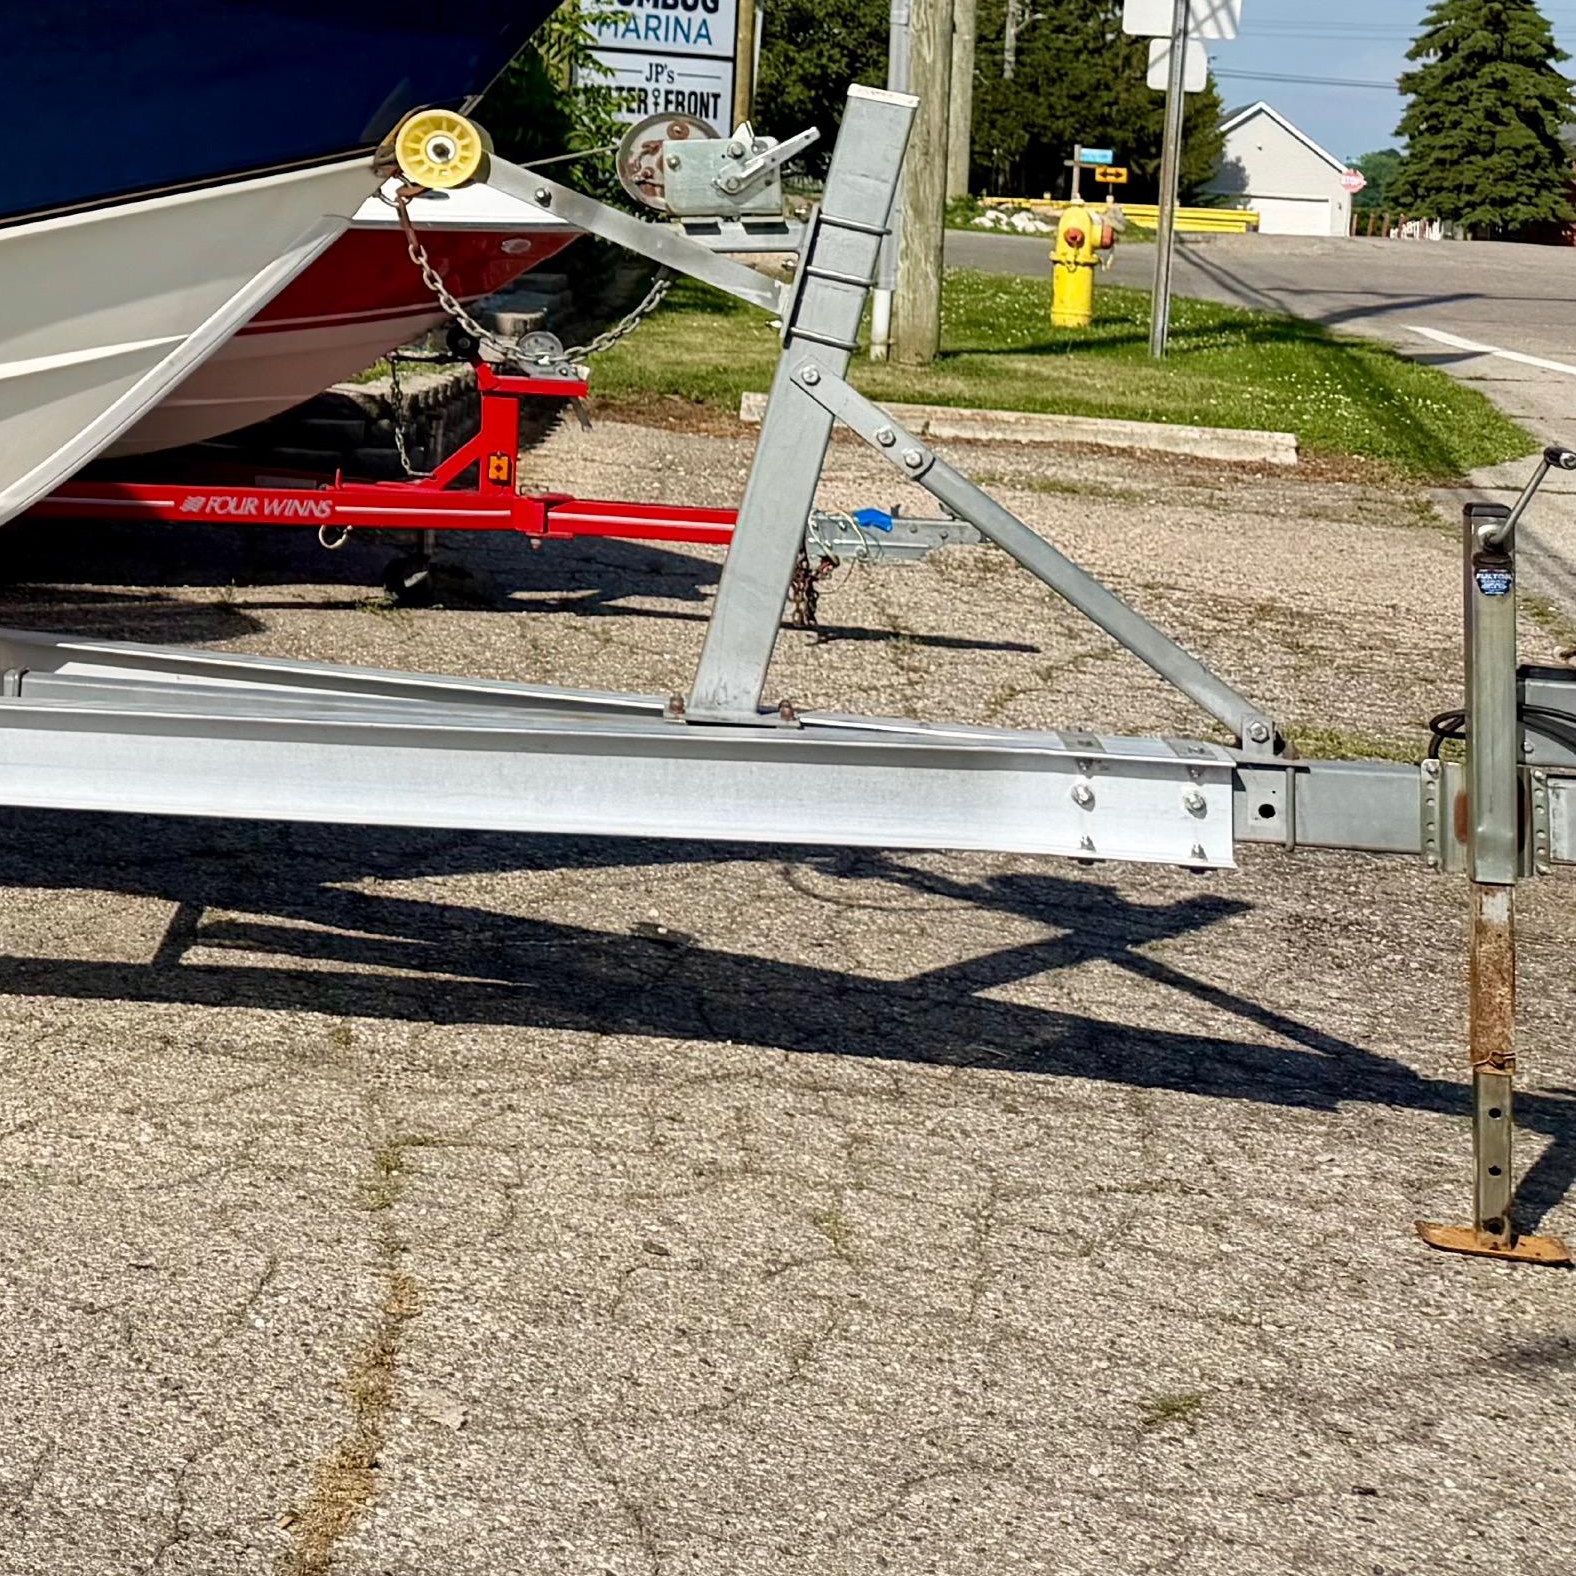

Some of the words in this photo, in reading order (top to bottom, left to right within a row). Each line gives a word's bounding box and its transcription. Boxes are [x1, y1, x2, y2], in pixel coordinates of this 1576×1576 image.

[597, 12, 713, 46] MARINA
[644, 62, 675, 84] JP's
[664, 89, 722, 120] FRONT
[205, 495, 260, 516] FOUR
[263, 497, 333, 519] WINNS
